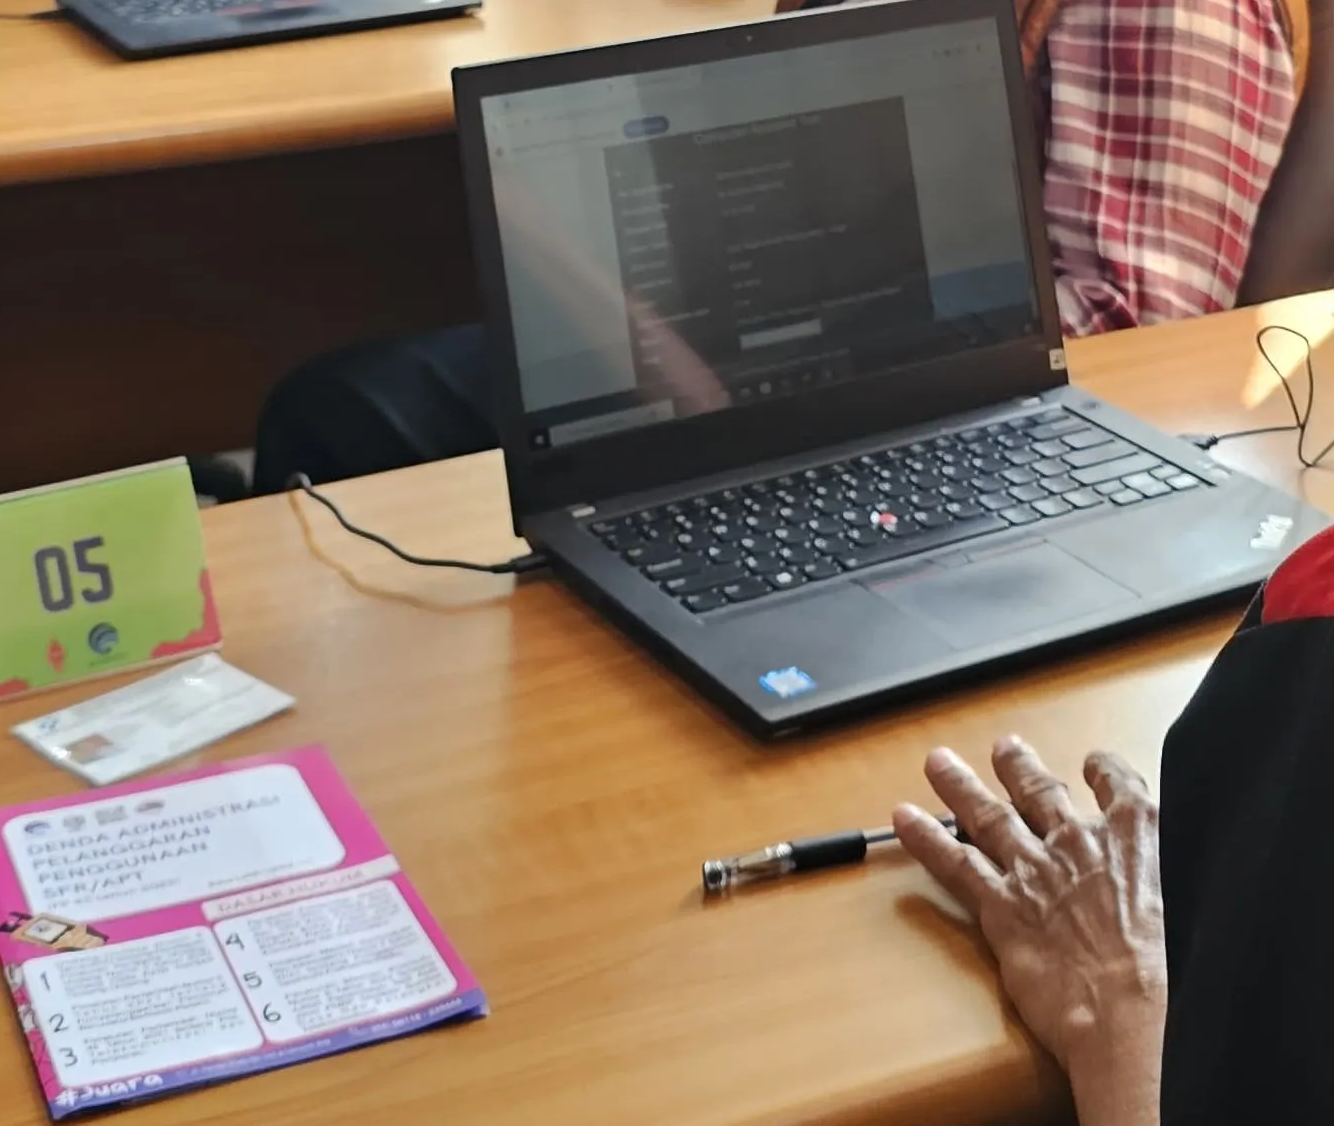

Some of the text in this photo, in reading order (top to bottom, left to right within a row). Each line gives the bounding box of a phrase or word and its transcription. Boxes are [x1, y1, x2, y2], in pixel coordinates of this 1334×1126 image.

[33, 535, 115, 614] 05
[26, 794, 281, 856] DENDA ADMINISTRASI
[31, 825, 212, 870] PELANGGARAN
[37, 841, 210, 884] PENGGUNAAN
[218, 888, 284, 913] DASAR
[225, 932, 245, 951] 4
[40, 971, 51, 991] 1
[243, 971, 263, 989] 5
[49, 1012, 68, 1033] 2
[262, 1002, 282, 1023] 6
[58, 1047, 78, 1068] 3
